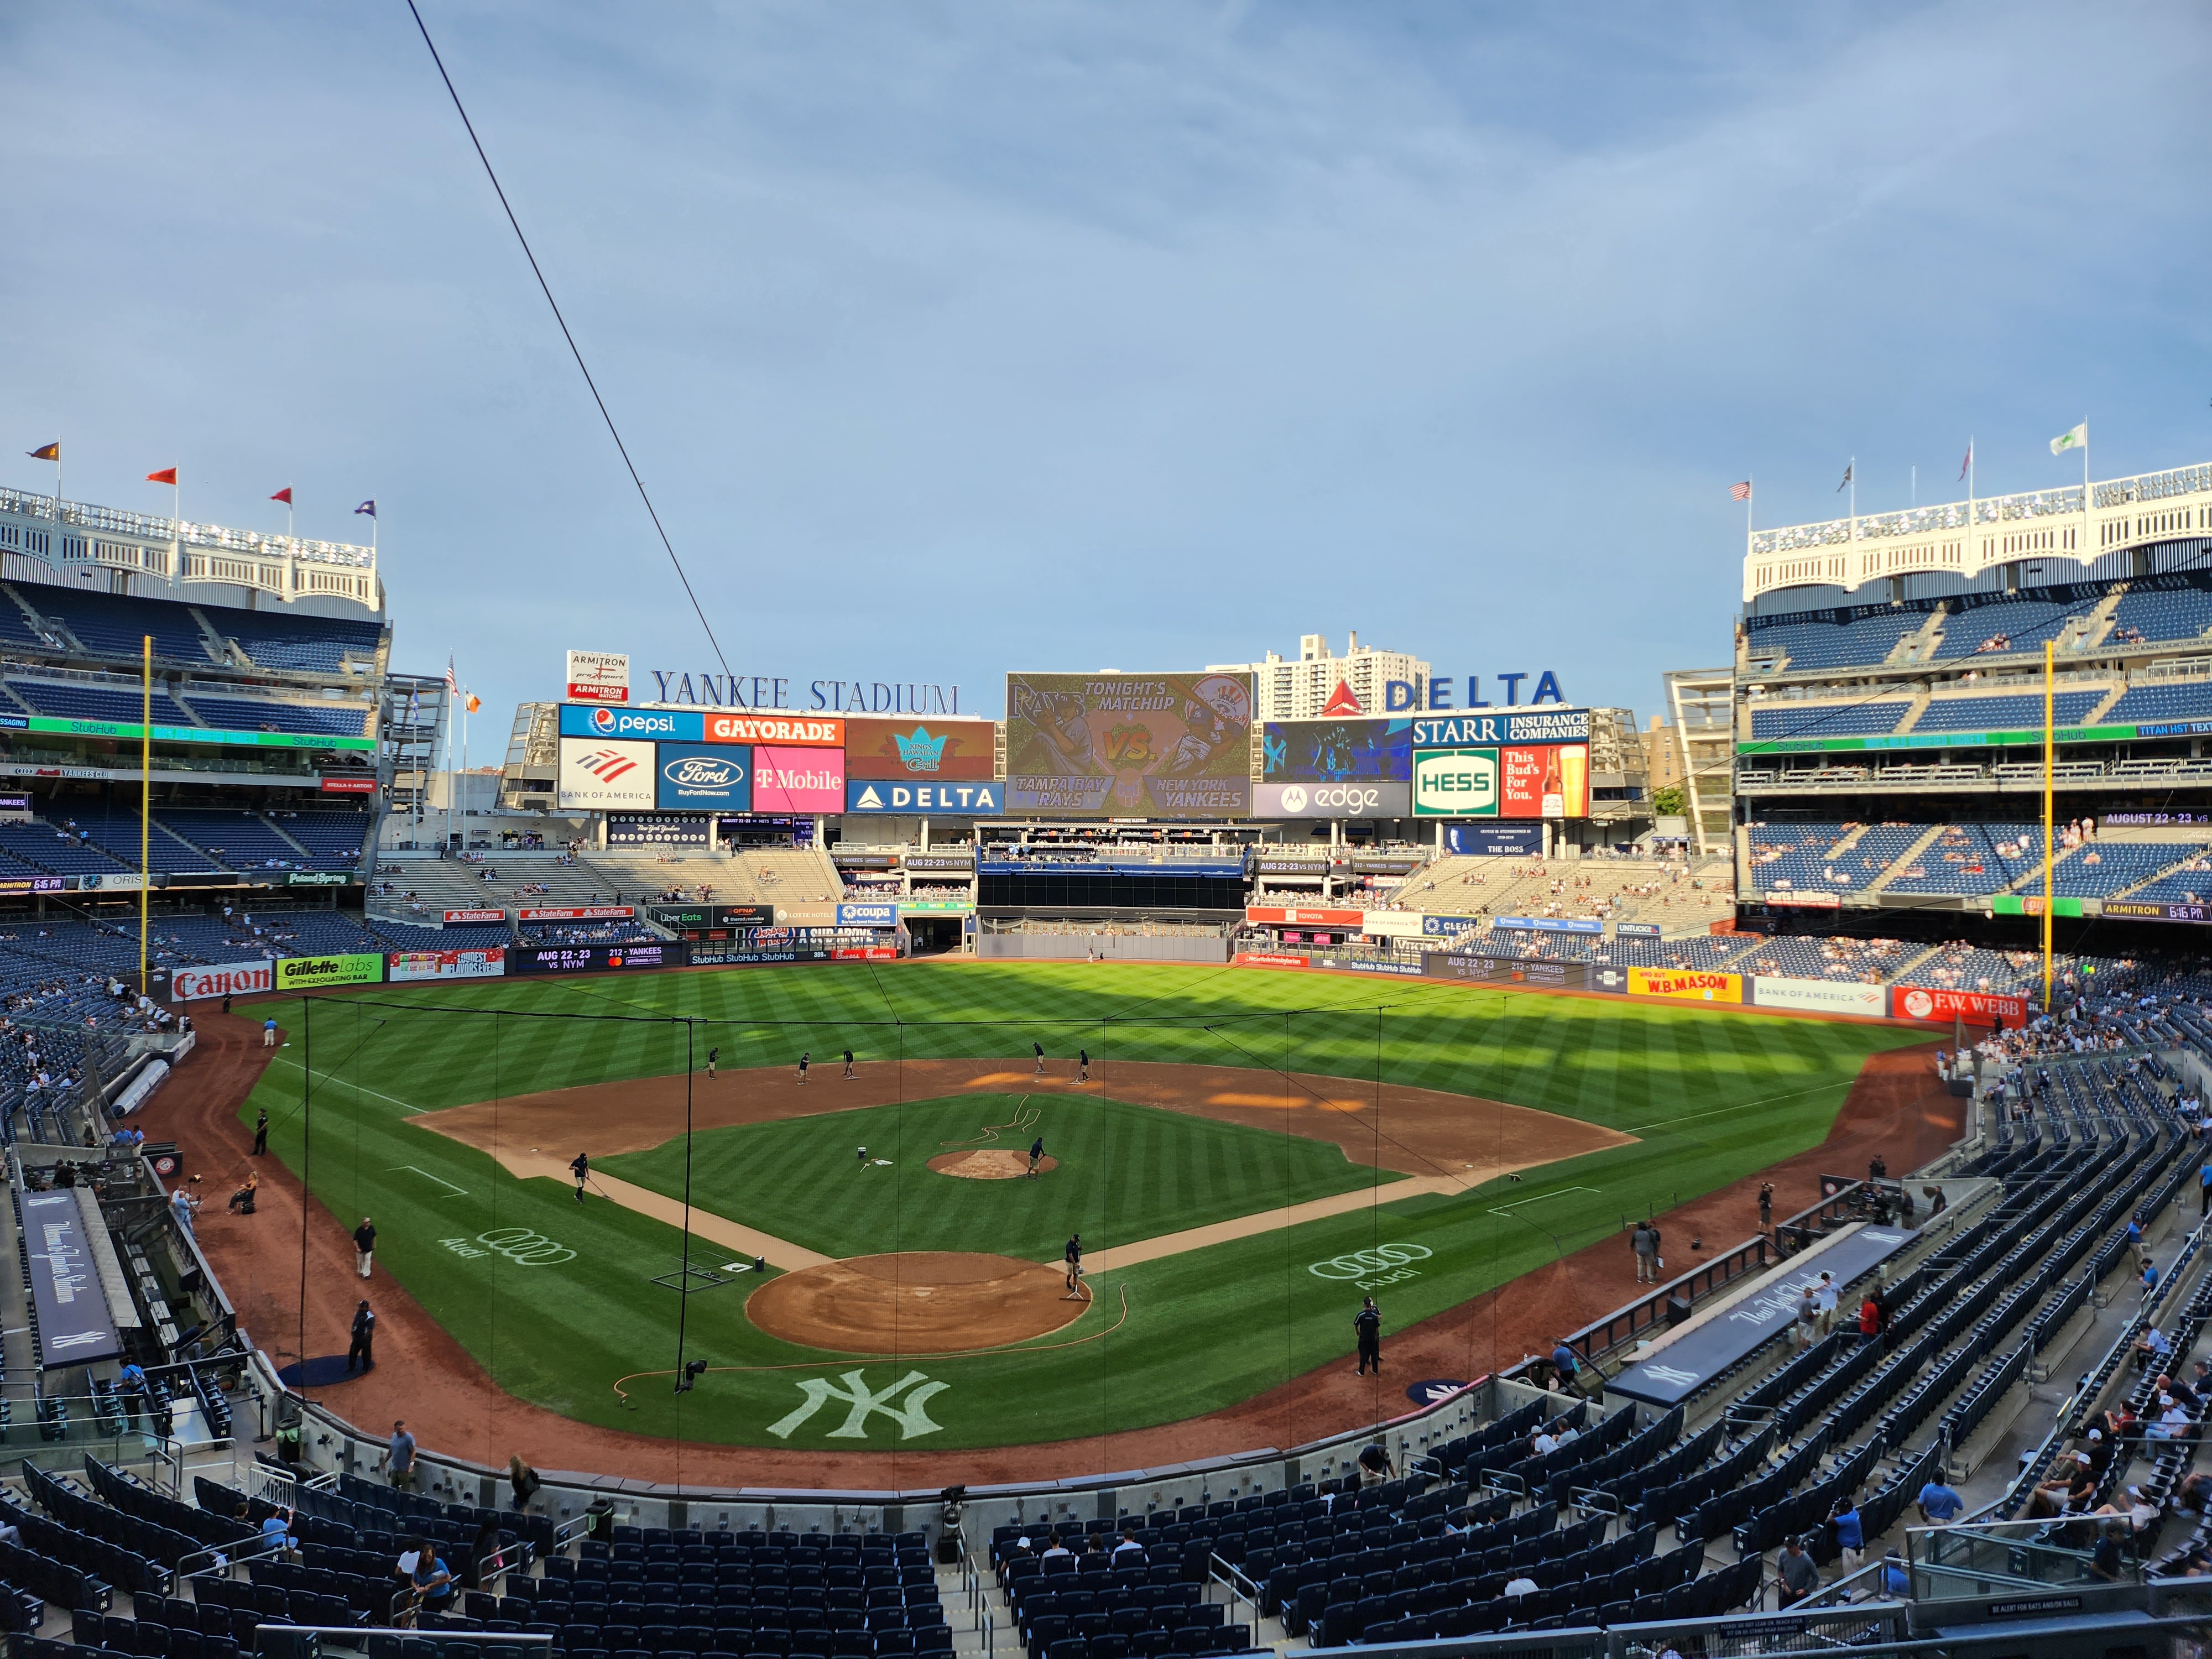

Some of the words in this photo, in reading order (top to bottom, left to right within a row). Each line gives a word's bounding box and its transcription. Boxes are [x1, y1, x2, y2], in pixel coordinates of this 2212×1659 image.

[572, 655, 625, 666] ARMITRON
[575, 685, 623, 695] ARMITRON
[650, 670, 789, 709] YANKEE
[810, 680, 961, 715] STADIUM
[1085, 682, 1166, 696] TONIGHT'S
[1385, 670, 1567, 711] DELTA
[1098, 697, 1175, 711] MATCHUP
[619, 716, 673, 733] pepsi
[1510, 713, 1589, 728] INSURANCE
[71, 721, 117, 734] StubHub
[714, 719, 836, 741] GATORADE
[1413, 719, 1500, 743] STARR
[1510, 726, 1589, 740] COMPANIES
[2140, 726, 2168, 735] TITAN
[2170, 724, 2188, 733] HST
[293, 736, 337, 747] StubHub
[2032, 729, 2086, 742] StbHub
[1102, 732, 1156, 761] VS.
[1777, 741, 1825, 752] StubHub
[1505, 751, 1534, 763] This
[906, 758, 940, 771] Grill
[1506, 764, 1540, 775] Bud's
[62, 769, 94, 778] YANKEES
[679, 761, 730, 783] Ford
[1016, 776, 1067, 791] TAMPA
[1072, 777, 1105, 791] BAY
[1156, 779, 1188, 791] NEW
[1191, 779, 1227, 791] YORK
[1422, 773, 1489, 792] HESS
[1506, 776, 1527, 787] For
[893, 787, 994, 807] DELTA
[1037, 792, 1084, 807] RAYS
[1165, 792, 1241, 807] YANKEES
[1314, 785, 1379, 815] edge
[1505, 789, 1532, 800] You.
[2106, 813, 2152, 823] AUGUST
[2154, 813, 2168, 823] 22
[2178, 813, 2192, 823] 23
[289, 873, 318, 884] Poland
[319, 874, 346, 884] Spring
[857, 907, 890, 919] coupa
[2106, 905, 2159, 915] ARMITRON
[2169, 907, 2188, 918] 6:16
[2190, 908, 2203, 919] PM
[799, 928, 807, 943] A
[457, 952, 486, 963] LOUDEST
[537, 951, 558, 961] AUG
[727, 954, 758, 962] StubHub
[1448, 957, 1465, 967] AUG
[563, 960, 585, 969] NYM
[1399, 966, 1421, 974] StubHub
[1512, 962, 1524, 971] 212
[1530, 964, 1564, 974] YANKEES
[308, 975, 351, 984] EXFOLIATING
[1469, 968, 1489, 978] NYM
[173, 968, 270, 998] Canon
[1758, 988, 1787, 997] BANK
[1790, 990, 1802, 998] OF
[1805, 992, 1855, 1002] AMERICA
[1934, 993, 1965, 1010] F.W.
[1970, 997, 2019, 1016] WEBB
[2028, 1003, 2038, 1011] 314
[438, 1238, 491, 1258] Audi
[1355, 1267, 1422, 1290] Audi
[765, 1368, 951, 1440] NY
[2001, 1604, 2016, 1613] ALERT
